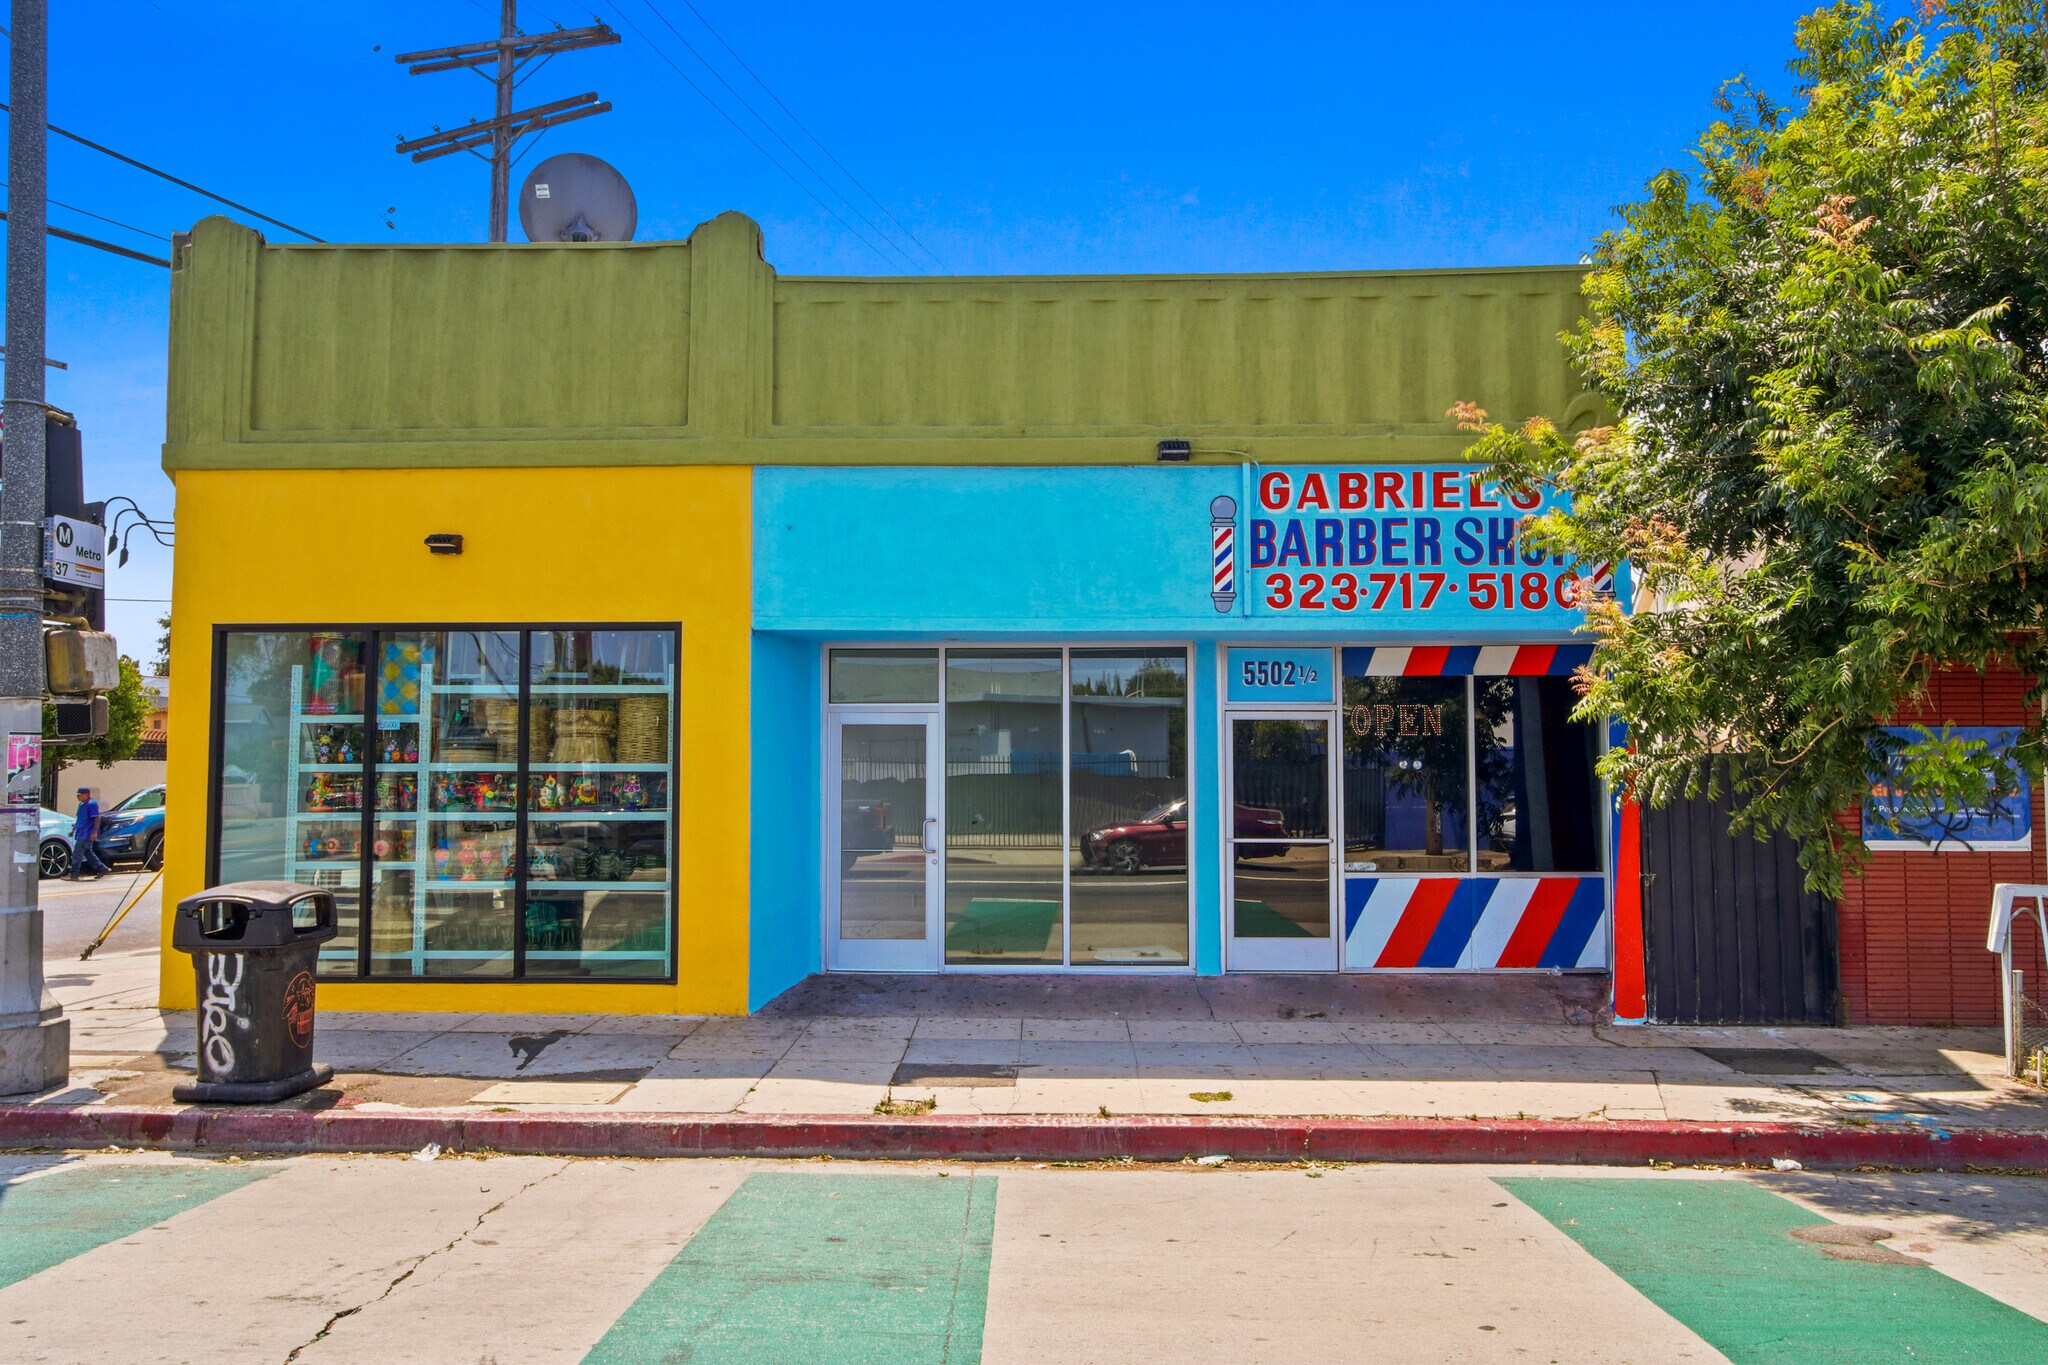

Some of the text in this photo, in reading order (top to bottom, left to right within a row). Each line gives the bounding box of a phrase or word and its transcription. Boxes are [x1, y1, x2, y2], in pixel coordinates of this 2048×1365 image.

[1250, 516, 1565, 568] BARBER SHO
[75, 545, 101, 561] Metro
[55, 561, 68, 576] 37
[1243, 661, 1295, 687] 5502
[1351, 704, 1442, 736] OPEN
[1210, 1118, 1265, 1128] ZONE
